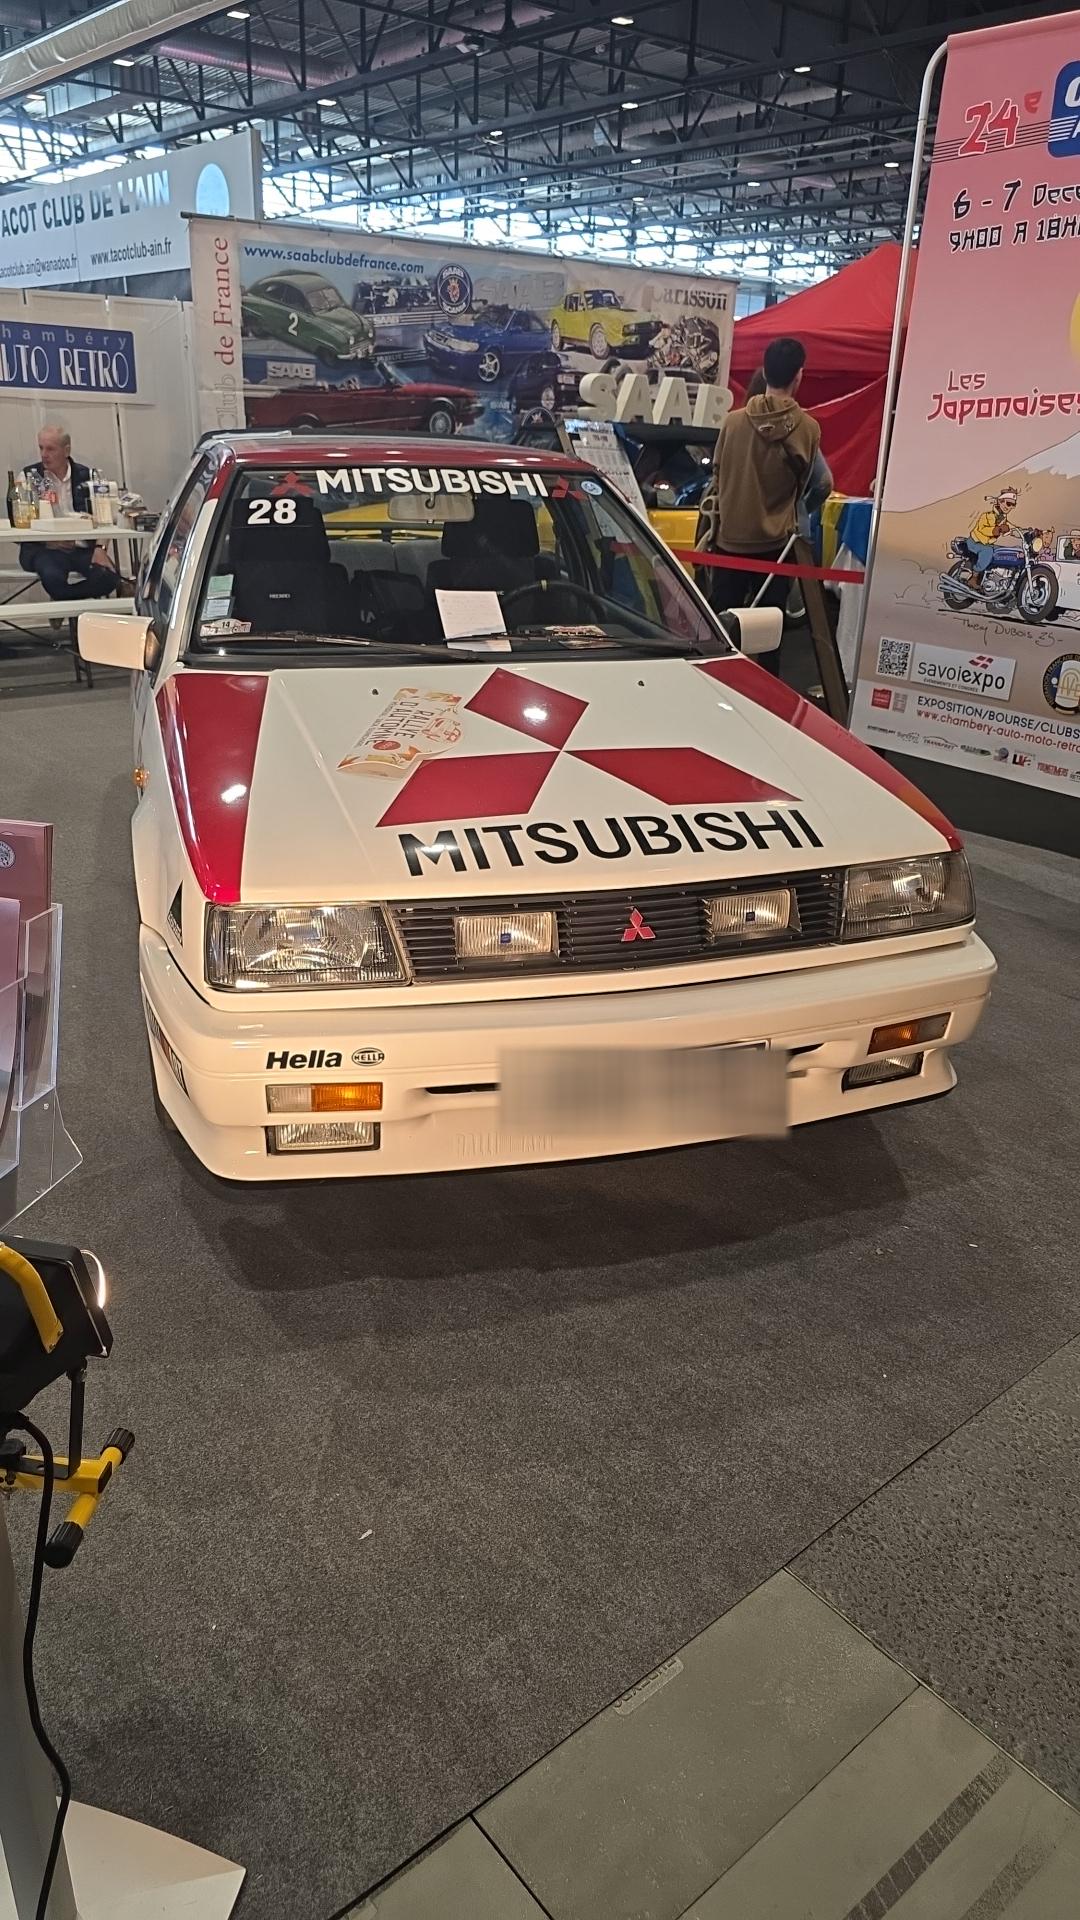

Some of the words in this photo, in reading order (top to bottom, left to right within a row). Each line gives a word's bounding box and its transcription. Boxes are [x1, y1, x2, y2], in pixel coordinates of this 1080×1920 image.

[1, 203, 37, 237] ACOT
[43, 193, 84, 229] CLUB
[90, 184, 113, 220] DE
[117, 170, 170, 214] L'AIN
[953, 188, 971, 220] 6
[1003, 178, 1022, 212] 7
[1032, 183, 1080, 208] Dec
[949, 224, 1003, 254] 9H00
[1012, 220, 1029, 246] A
[1035, 214, 1080, 242] 18H
[90, 237, 172, 266] www.tacotclub-ain.fr
[244, 246, 424, 274] www.saabclubdefrance.com
[213, 237, 233, 327] France
[288, 312, 299, 336] 2
[0, 343, 49, 385] UTO
[59, 347, 129, 389] RETRO
[214, 336, 235, 366] de
[267, 362, 316, 379] SAAB
[947, 370, 986, 392] Les
[577, 373, 734, 429] SAAB
[926, 388, 1080, 425] Japonaise
[316, 468, 548, 497] MITSUBISHI
[248, 499, 297, 525] 28
[221, 621, 230, 629] 14
[917, 661, 1006, 693] savoiexpo
[394, 709, 435, 739] RALLYE
[398, 808, 823, 877] MITSUBISHI
[265, 1049, 343, 1069] Hella
[354, 1052, 385, 1062] HELLA
